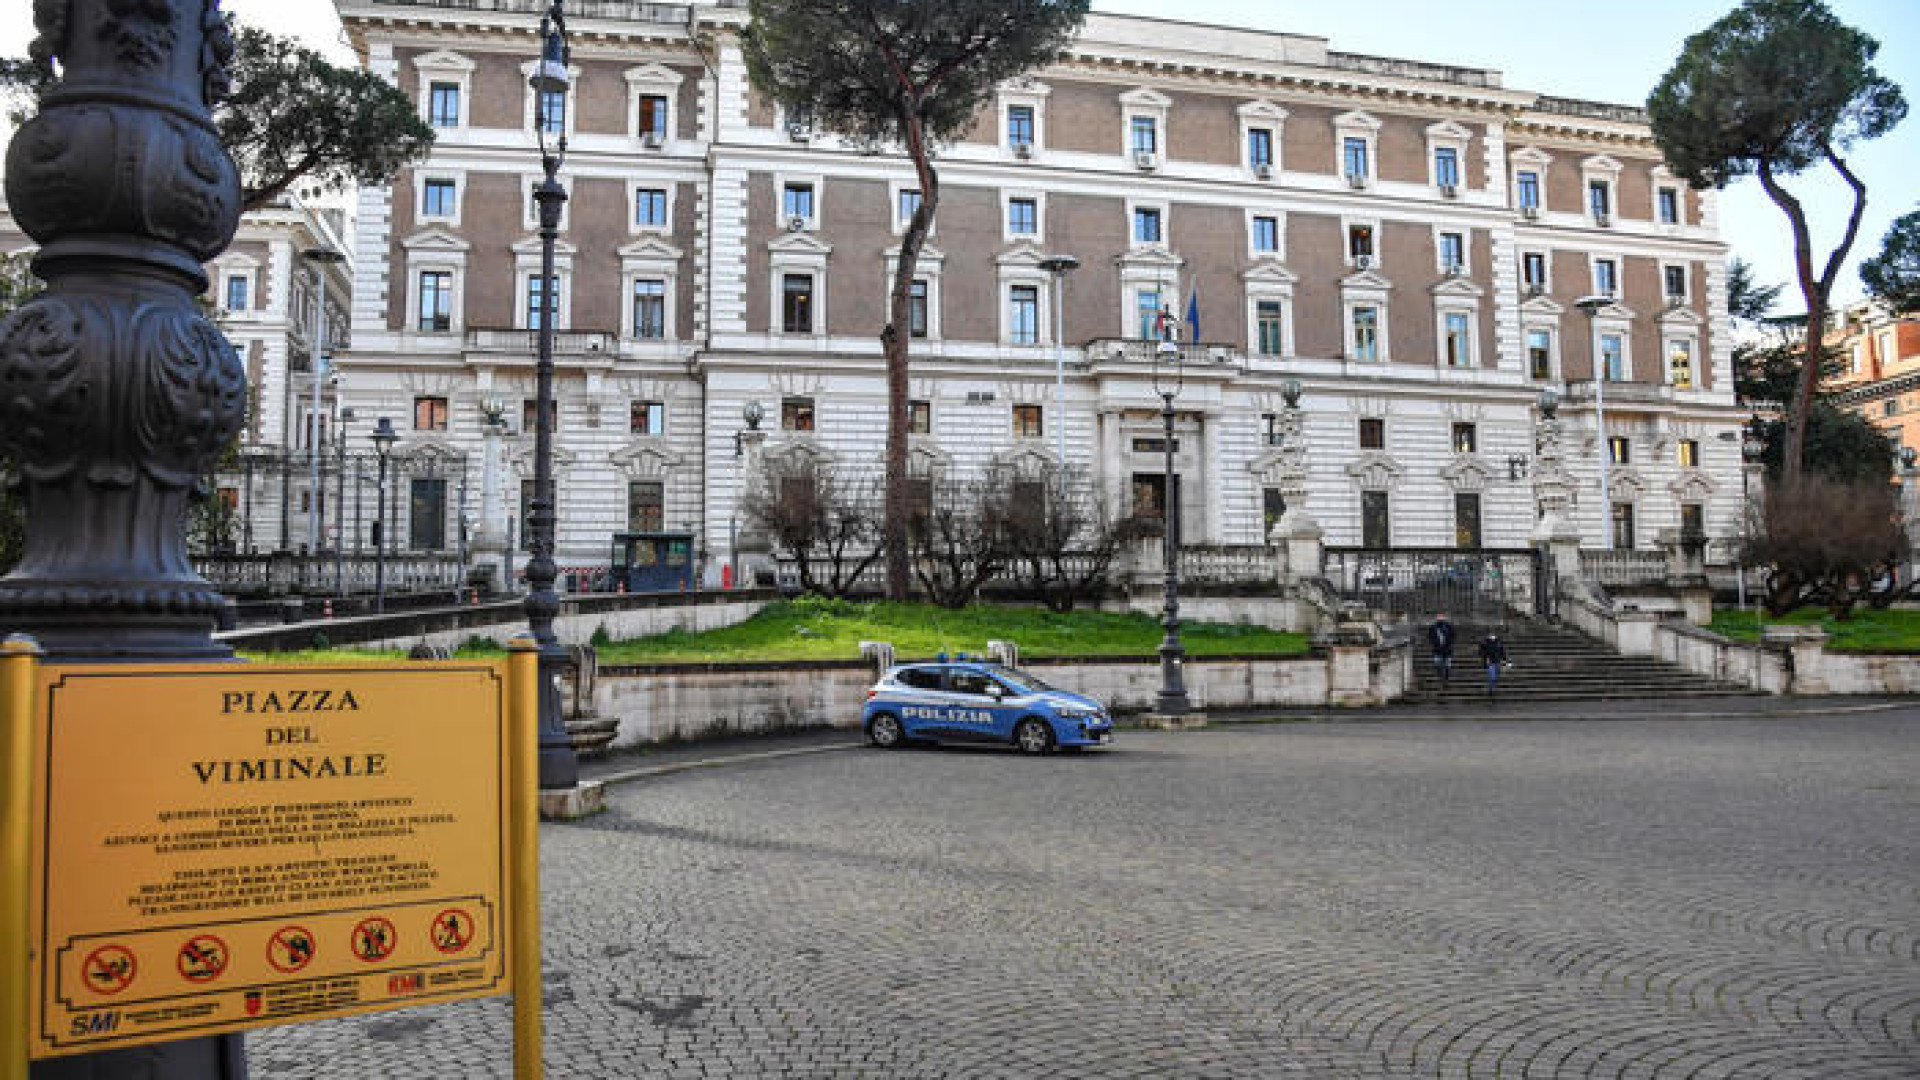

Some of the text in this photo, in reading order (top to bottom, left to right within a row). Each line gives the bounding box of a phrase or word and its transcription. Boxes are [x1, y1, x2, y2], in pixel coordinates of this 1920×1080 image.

[222, 690, 359, 713] PIAZZA
[901, 706, 994, 724] POLIZIA
[265, 726, 319, 744] DEL
[192, 753, 387, 784] VIMINALE
[70, 1011, 120, 1035] SMI
